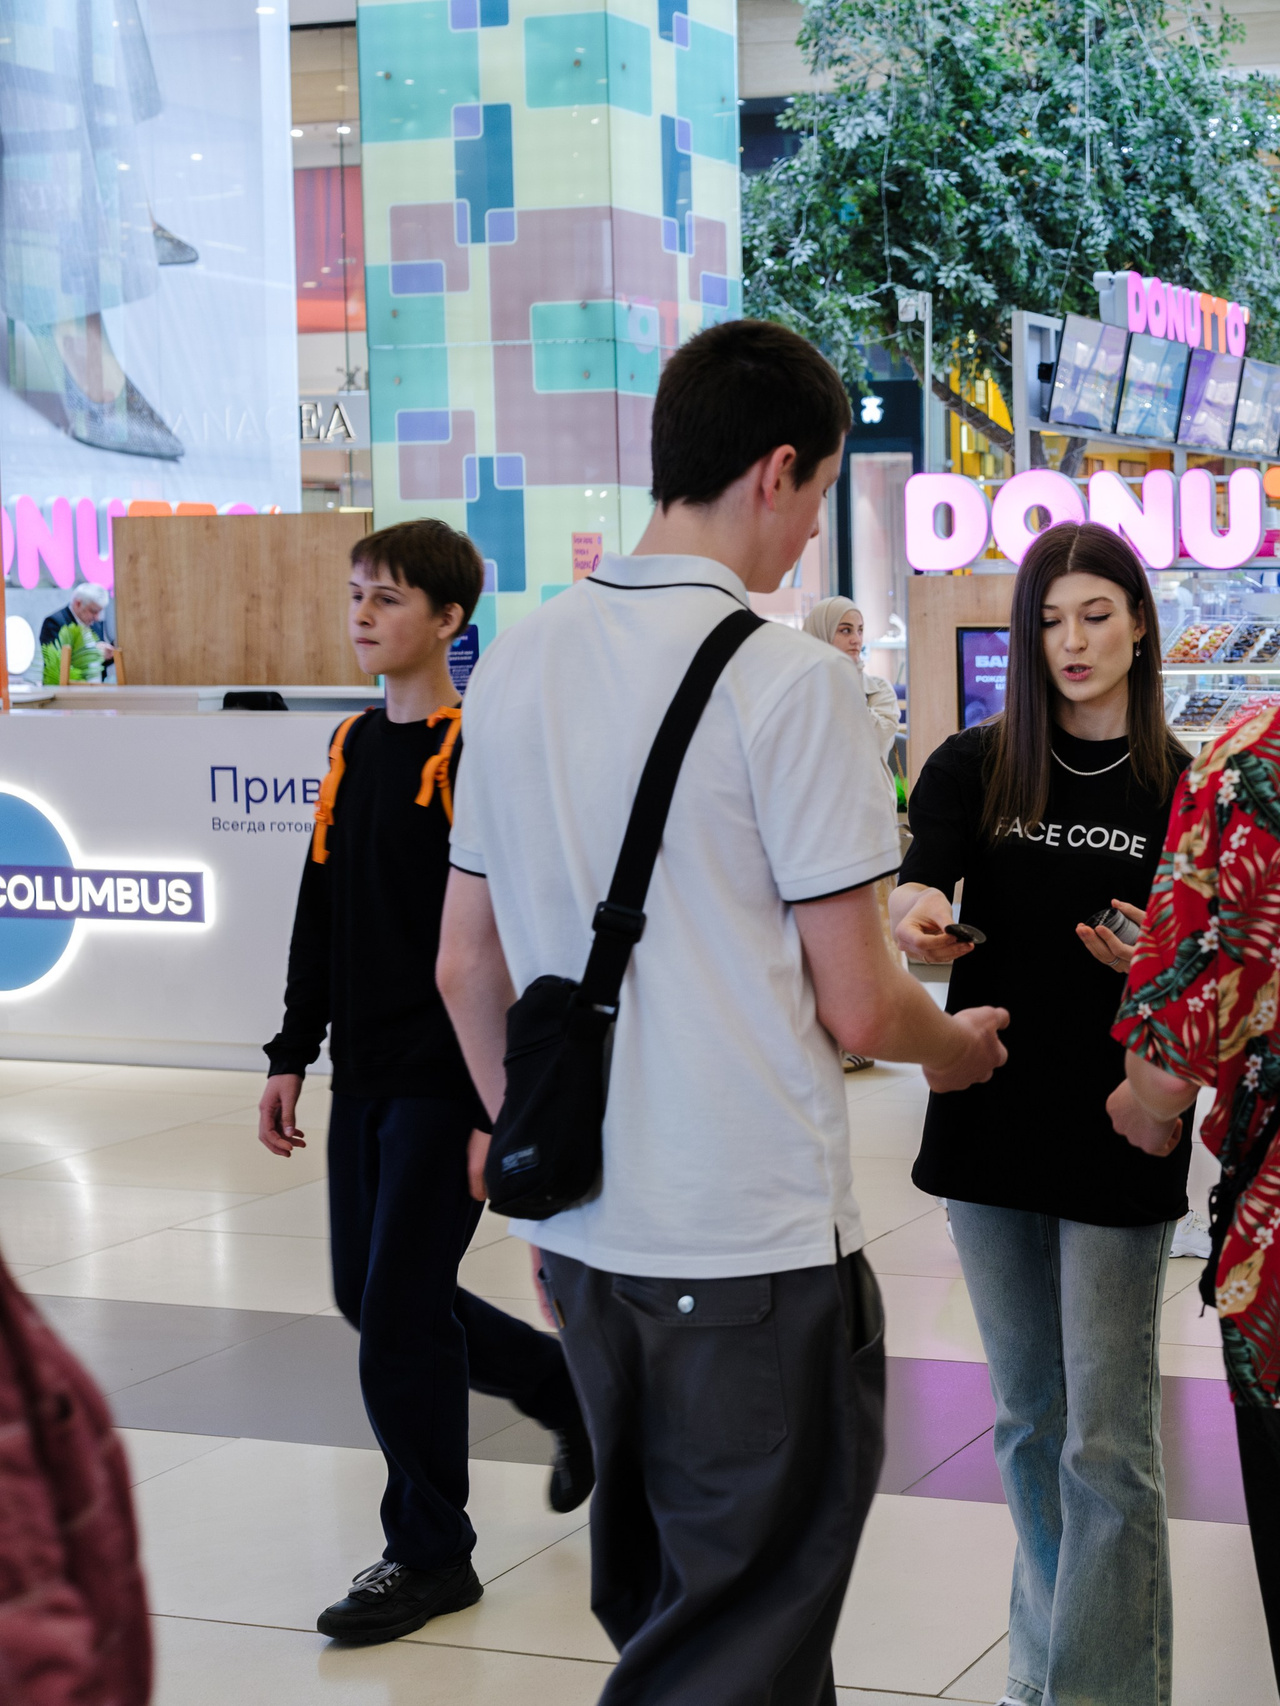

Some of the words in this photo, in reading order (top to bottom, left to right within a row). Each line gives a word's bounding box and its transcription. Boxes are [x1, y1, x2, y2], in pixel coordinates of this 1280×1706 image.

[1127, 270, 1247, 358] DONUTTO
[212, 817, 265, 834] Всегда
[270, 821, 316, 833] готов
[1067, 824, 1147, 859] CODE
